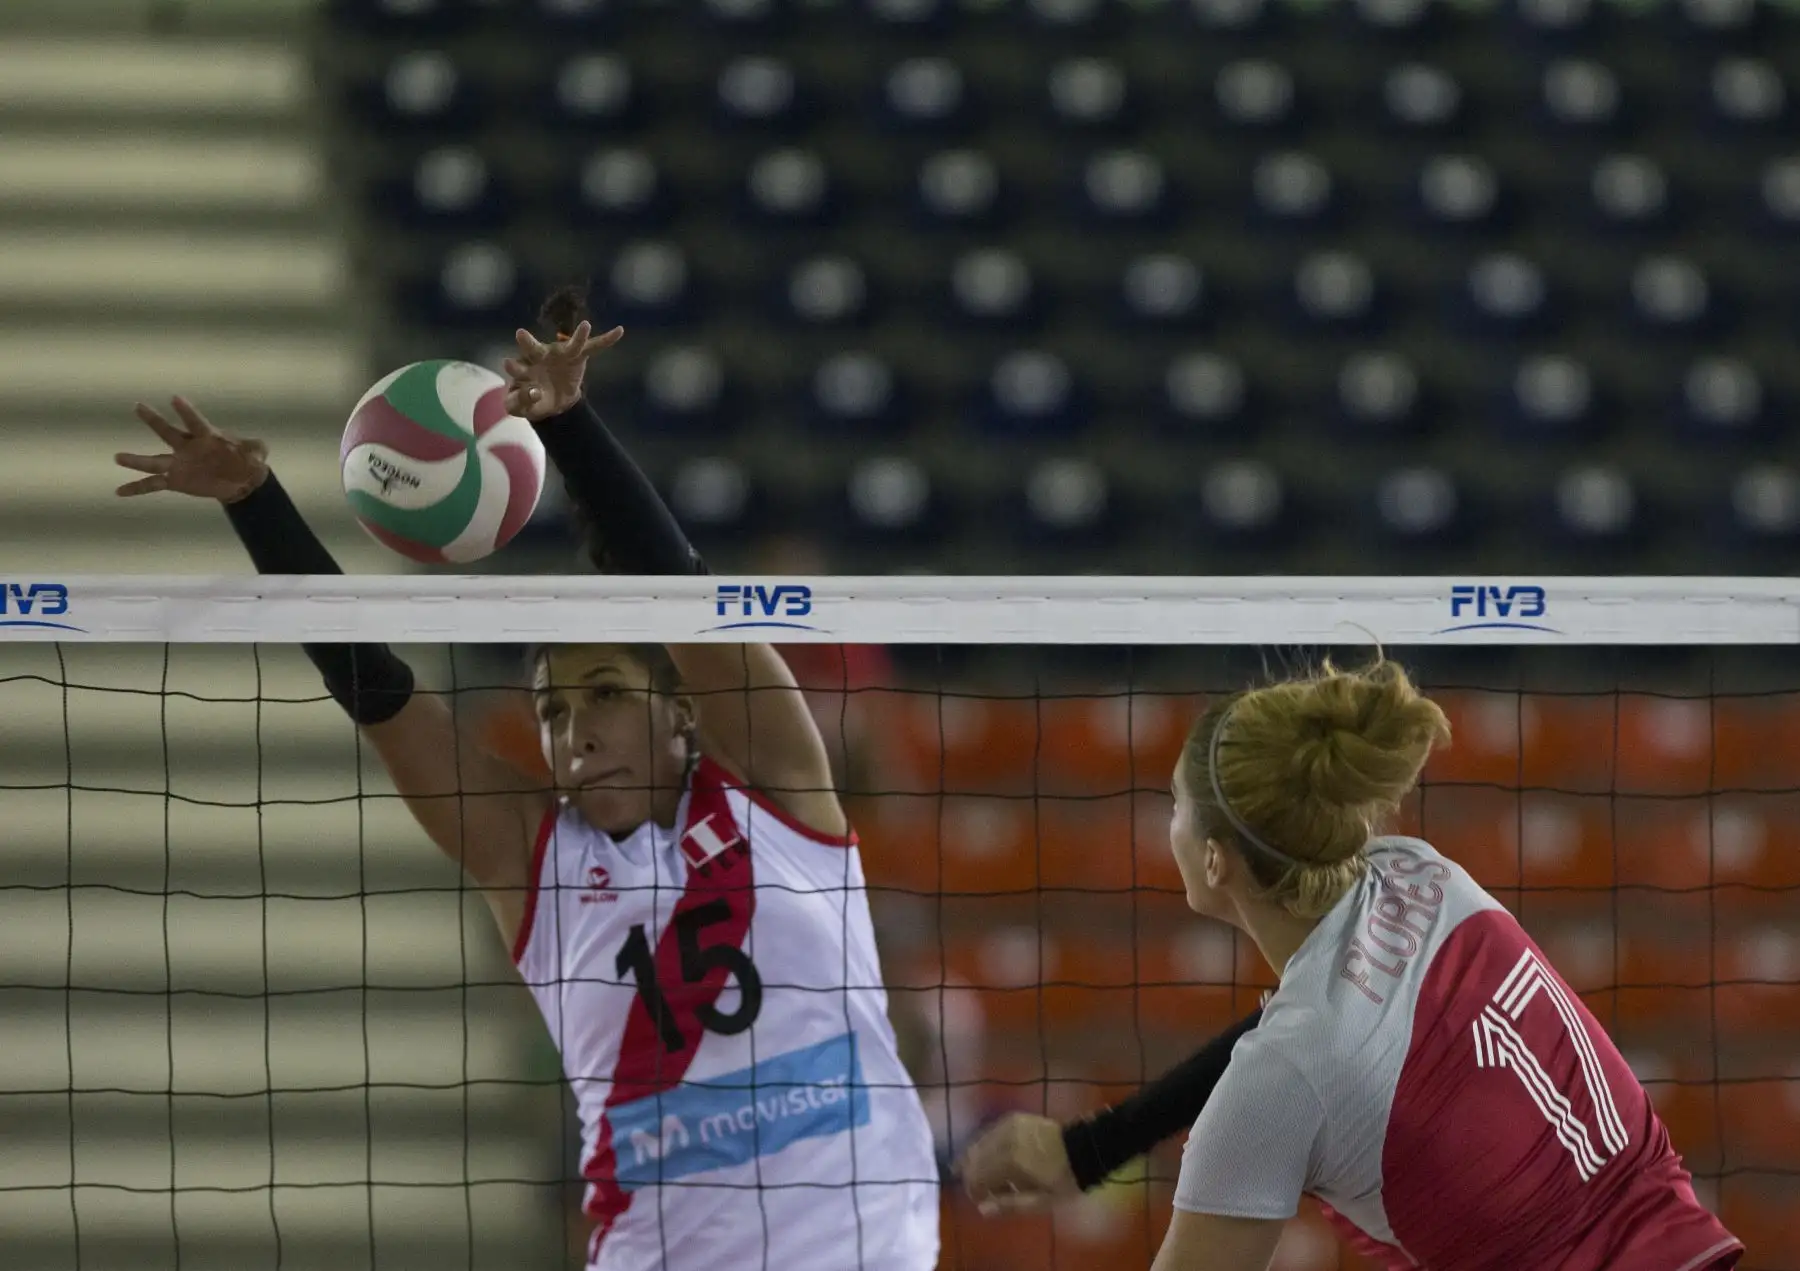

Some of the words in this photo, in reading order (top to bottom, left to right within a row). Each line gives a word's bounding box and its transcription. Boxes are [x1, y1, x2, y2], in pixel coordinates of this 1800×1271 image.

[0, 583, 68, 615] IVB
[717, 585, 812, 616] FIVB
[1452, 586, 1546, 617] FIVB
[1340, 851, 1452, 1005] FLORES
[615, 898, 763, 1054] 15
[1472, 947, 1629, 1182] 17
[700, 1074, 848, 1144] movistar
